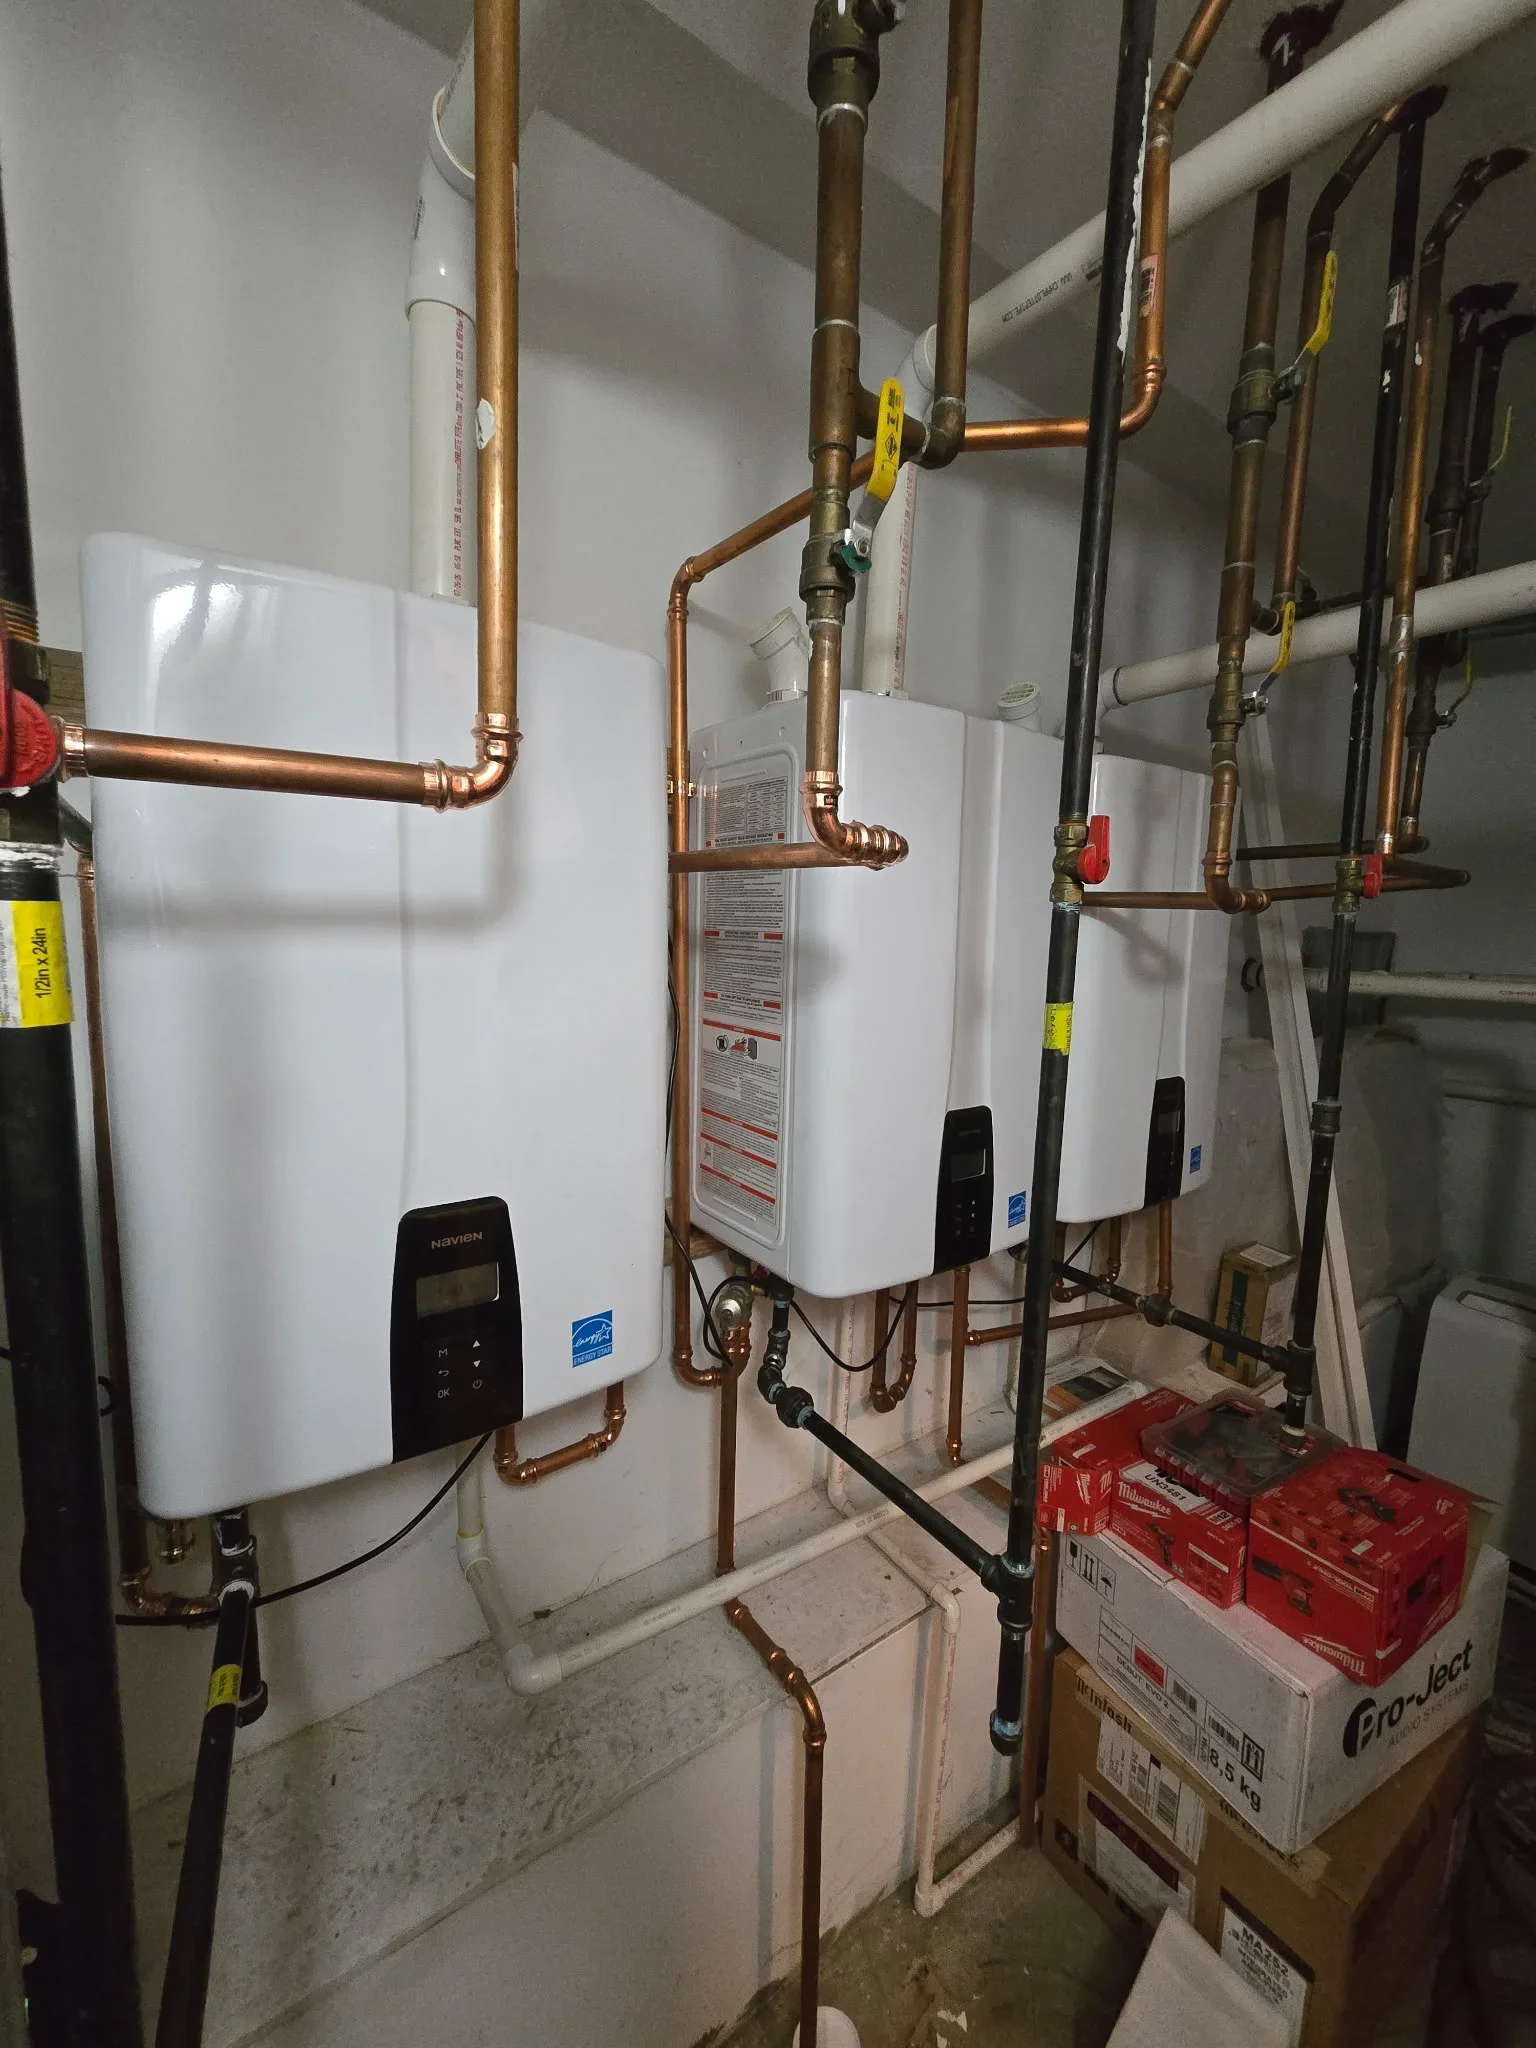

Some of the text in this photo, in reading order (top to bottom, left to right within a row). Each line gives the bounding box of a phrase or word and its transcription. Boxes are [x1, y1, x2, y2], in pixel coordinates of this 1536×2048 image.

[31, 927, 52, 999] 1/2in x 24in
[438, 1348, 449, 1358] M
[573, 1345, 612, 1365] ENERGY STAR
[437, 1388, 450, 1399] OK
[1117, 1481, 1172, 1515] Milwaukee
[1145, 1473, 1187, 1500] UN3481
[1301, 1637, 1367, 1677] Milwaukee
[1116, 1655, 1169, 1709] DEBUT EVO 2
[1342, 1639, 1473, 1758] Pro-Ject
[1388, 1678, 1469, 1747] AUDIO SYSTEMS
[1209, 1748, 1235, 1782] 8,5
[1240, 1775, 1262, 1812] kg
